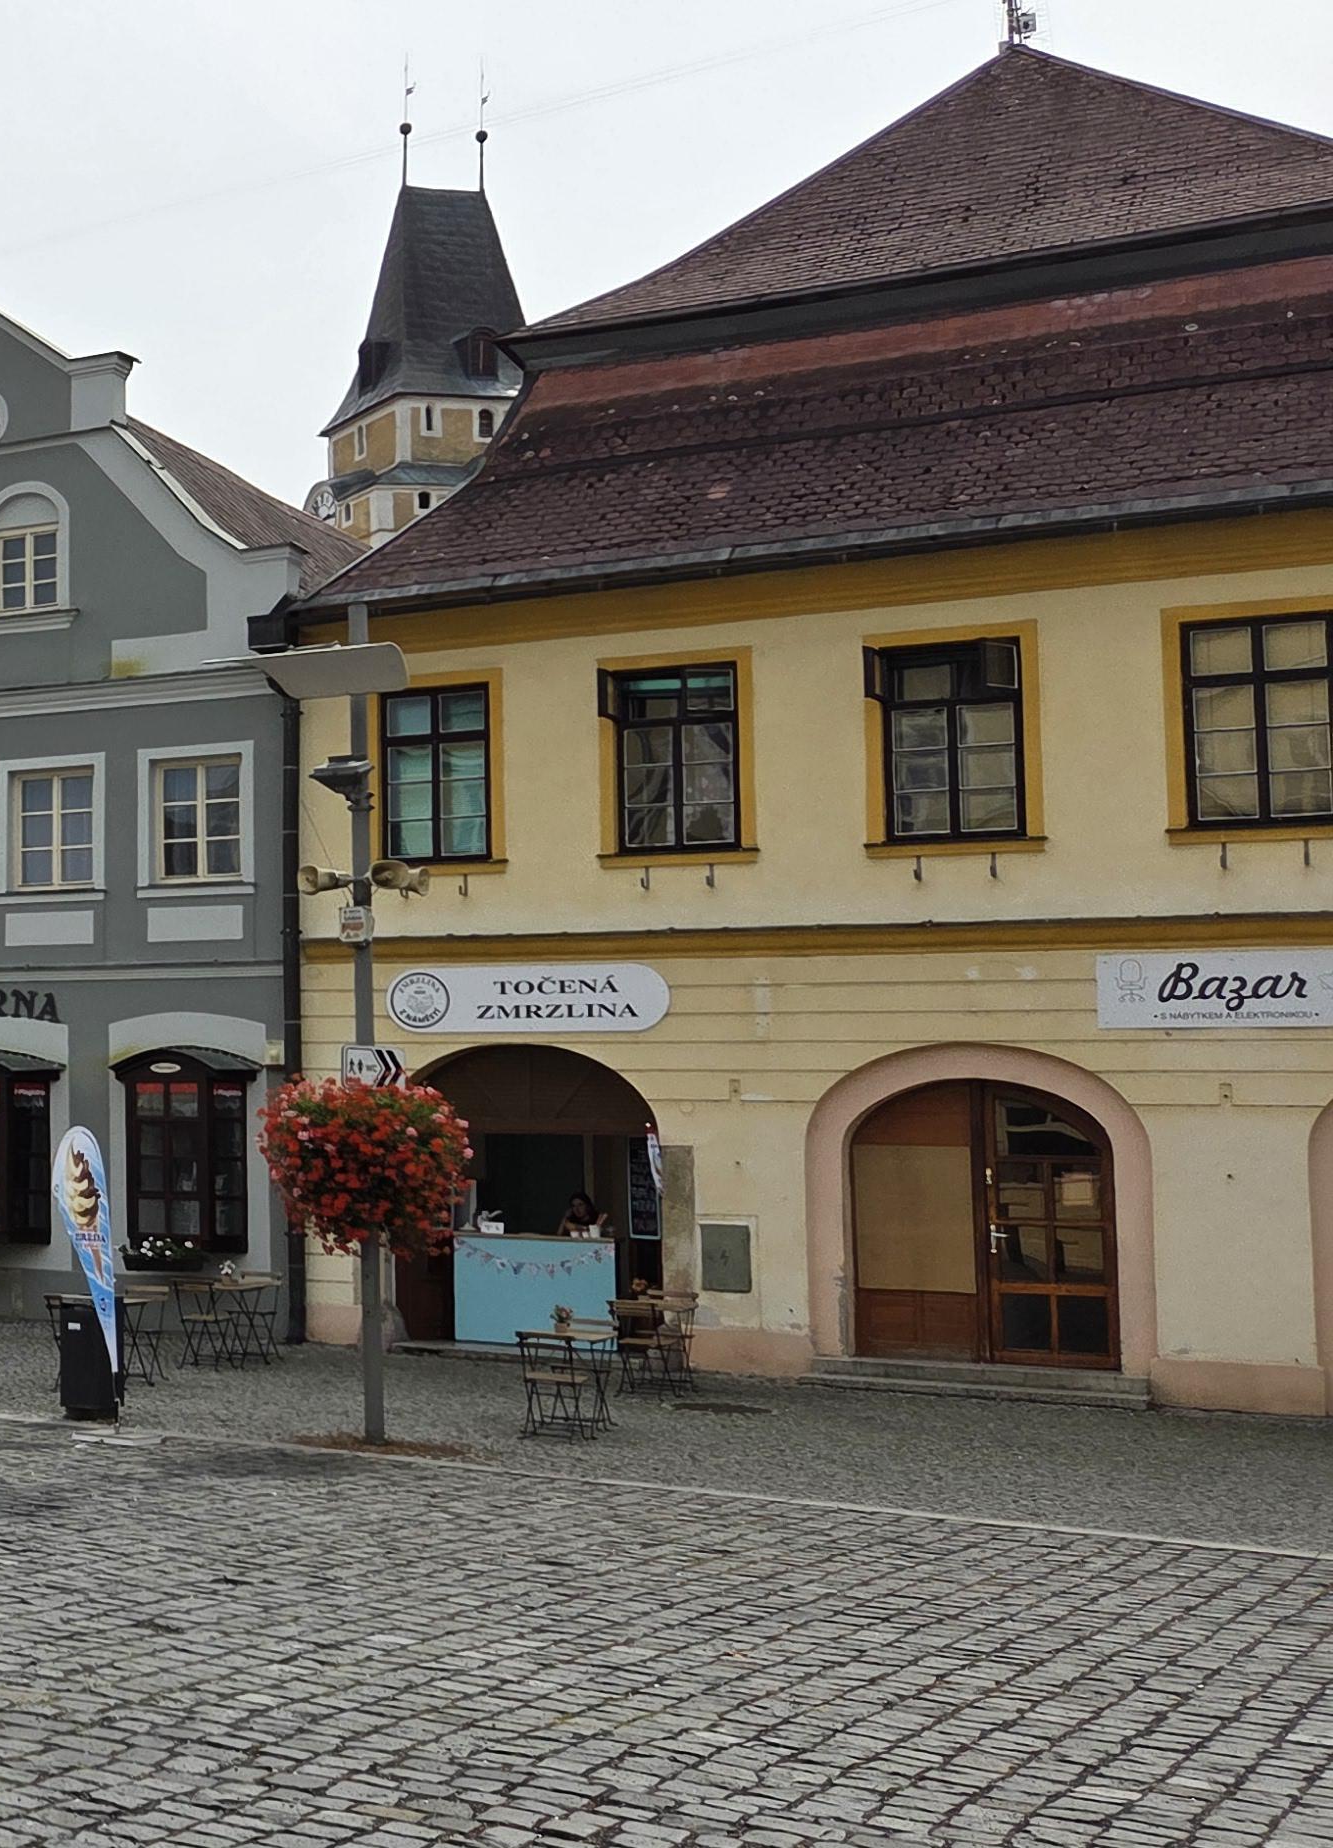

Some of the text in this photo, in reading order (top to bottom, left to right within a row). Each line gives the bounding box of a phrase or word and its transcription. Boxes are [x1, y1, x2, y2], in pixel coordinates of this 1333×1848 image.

[493, 975, 620, 995] TOČENÁ
[1158, 962, 1308, 1011] Bazar
[476, 1003, 639, 1020] ZMRZLINA
